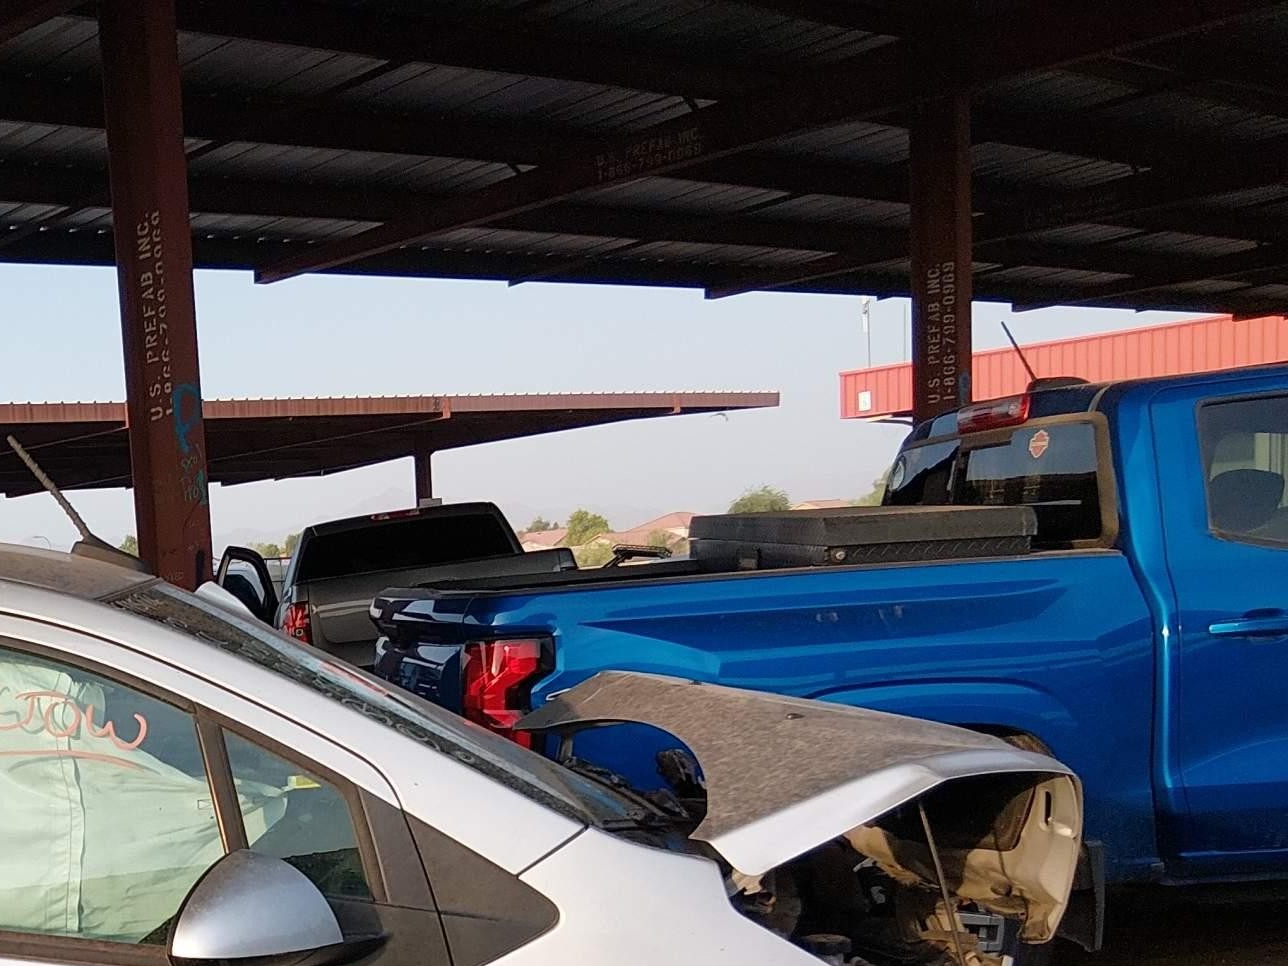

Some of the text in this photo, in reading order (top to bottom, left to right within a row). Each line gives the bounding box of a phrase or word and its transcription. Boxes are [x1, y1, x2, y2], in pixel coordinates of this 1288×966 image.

[136, 211, 163, 421] U.S. PREFAB INC.
[927, 263, 941, 404] U.S. PREFAB INC.
